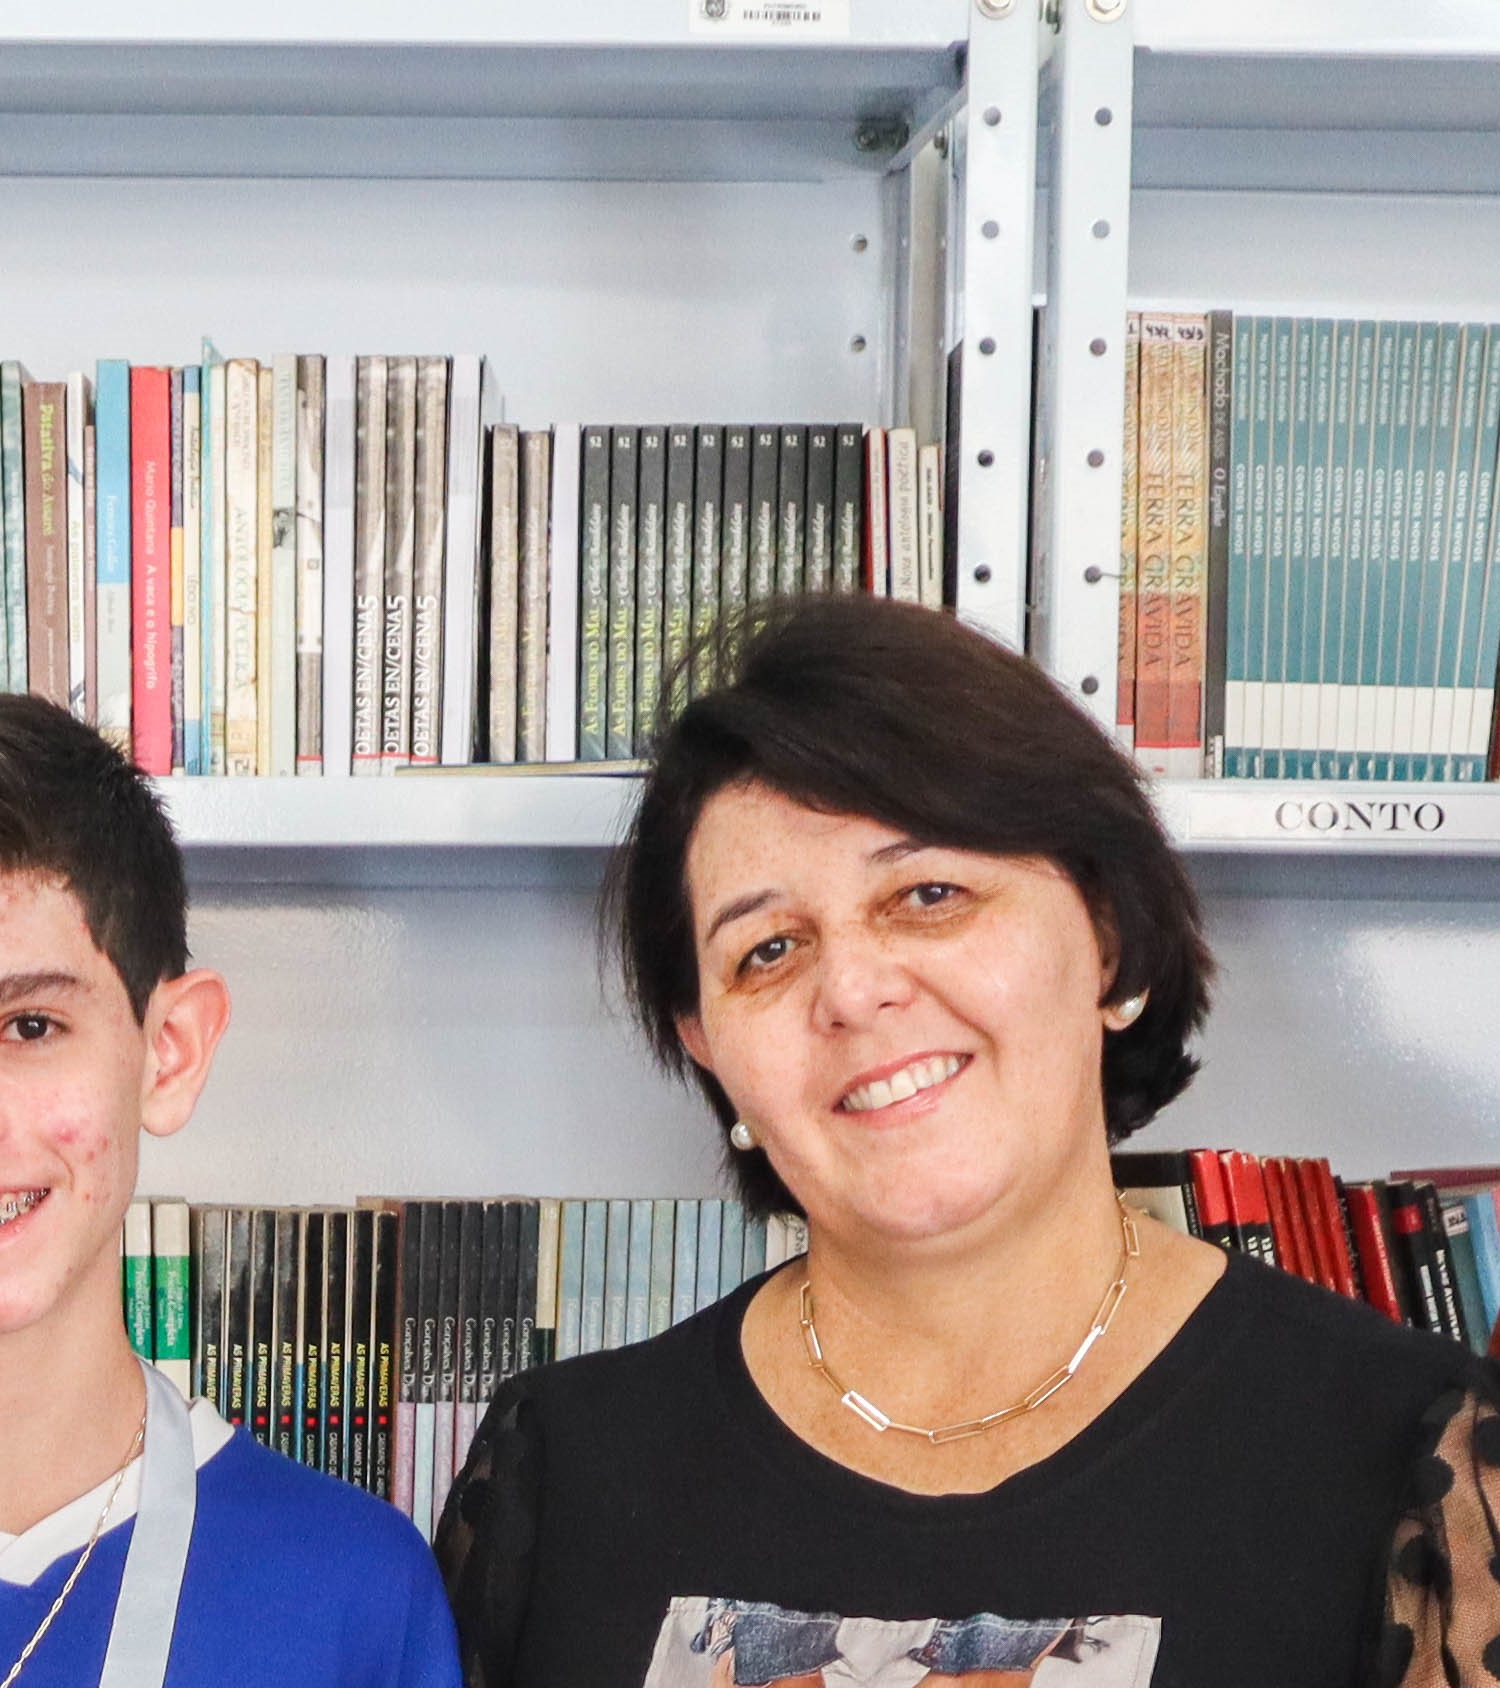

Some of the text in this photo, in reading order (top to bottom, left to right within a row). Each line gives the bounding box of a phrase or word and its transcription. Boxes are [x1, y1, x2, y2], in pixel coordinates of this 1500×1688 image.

[1214, 333, 1230, 410] Machado
[41, 404, 56, 471] Patativa
[1145, 473, 1164, 544] TERRA
[1175, 473, 1196, 544] TERRA
[1234, 464, 1245, 554] CONTOS NOVOS
[1273, 465, 1284, 556] CONTOS NOVOS
[1312, 466, 1323, 558] CONTOS NOVOS
[1351, 468, 1364, 559] CONTOS NOVOS
[1409, 470, 1424, 560] CONTOS NOVOS
[143, 461, 158, 689] Mario Quintana A vaca e o hipogrifo
[1275, 801, 1446, 831] CONTO
[281, 1342, 291, 1406] AS PRIMAVERAS
[329, 1343, 340, 1407] AS PRIMAVERAS
[378, 1343, 389, 1407] AS PRIMAVERAS
[403, 1317, 416, 1370] Gonçalves
[442, 1316, 454, 1368] Gonçalves
[463, 1318, 475, 1370] Gonçalves
